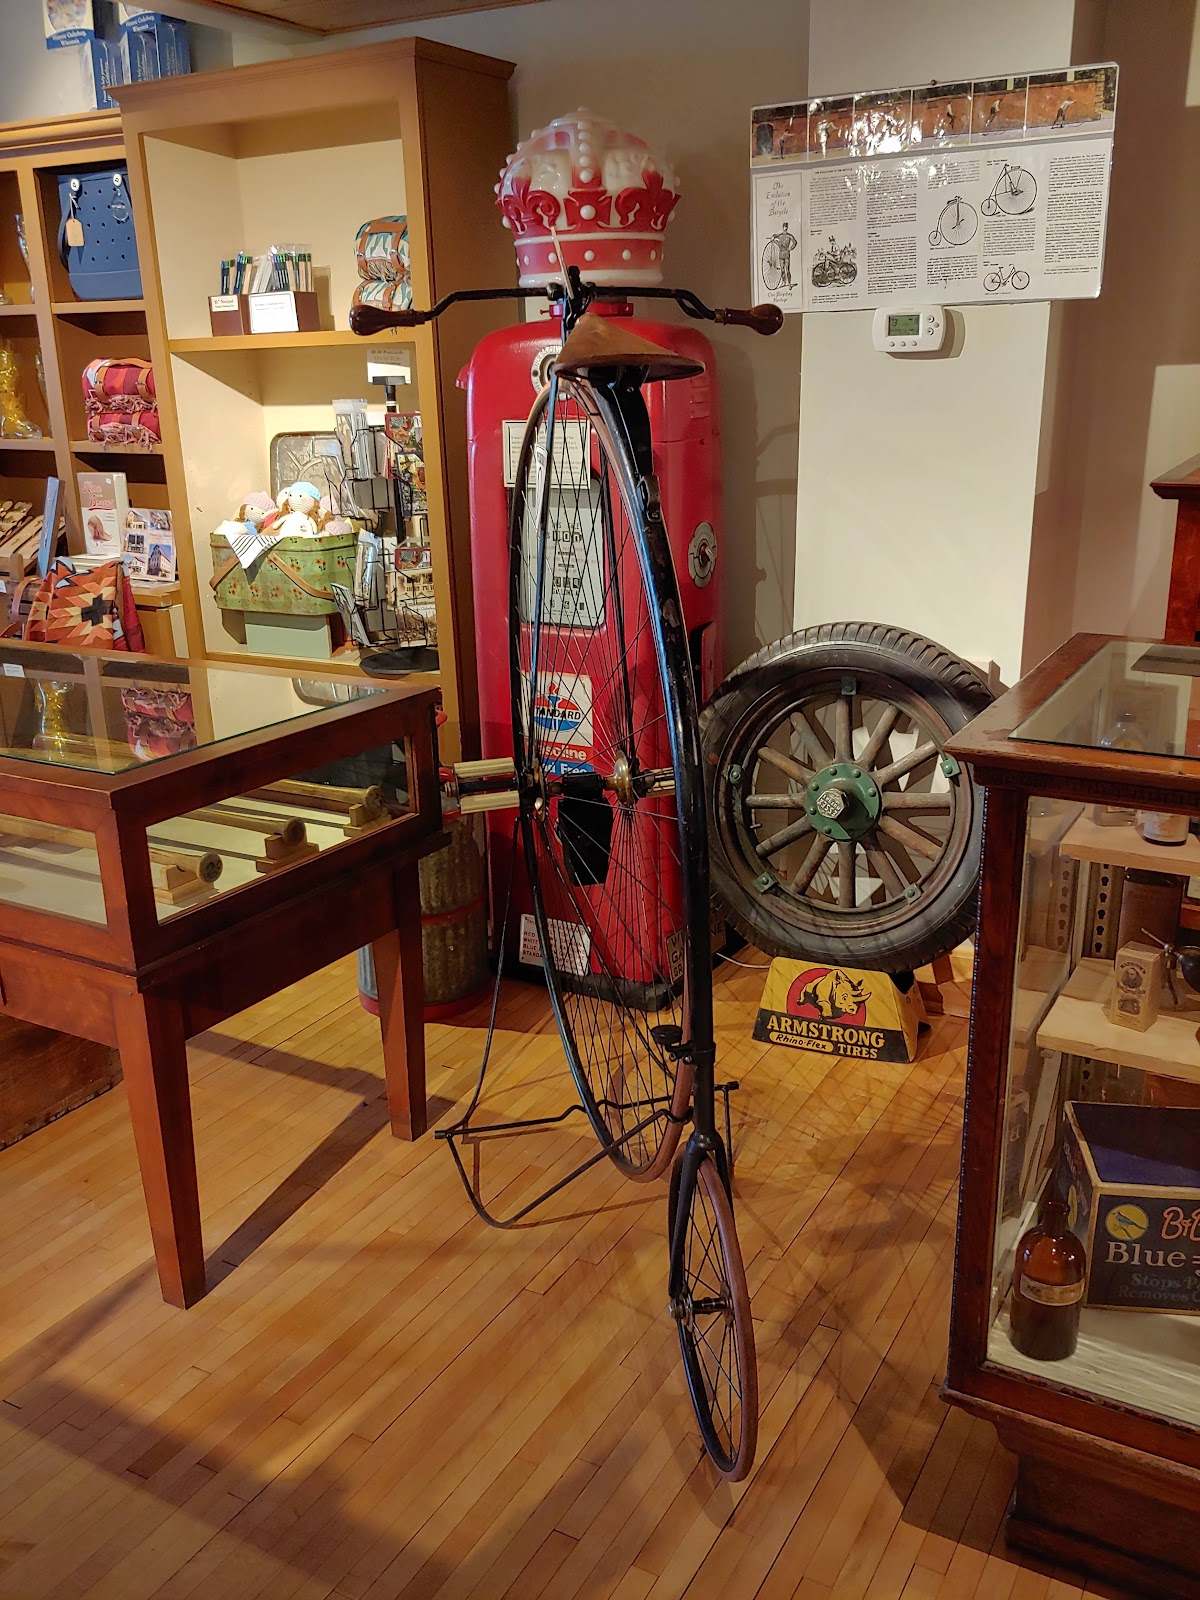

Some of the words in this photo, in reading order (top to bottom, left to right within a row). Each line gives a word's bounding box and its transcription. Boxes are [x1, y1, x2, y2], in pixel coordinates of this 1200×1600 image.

[536, 707, 581, 720] TANDARD
[766, 1014, 886, 1048] ARMSTRONG
[837, 1043, 879, 1059] TIRES
